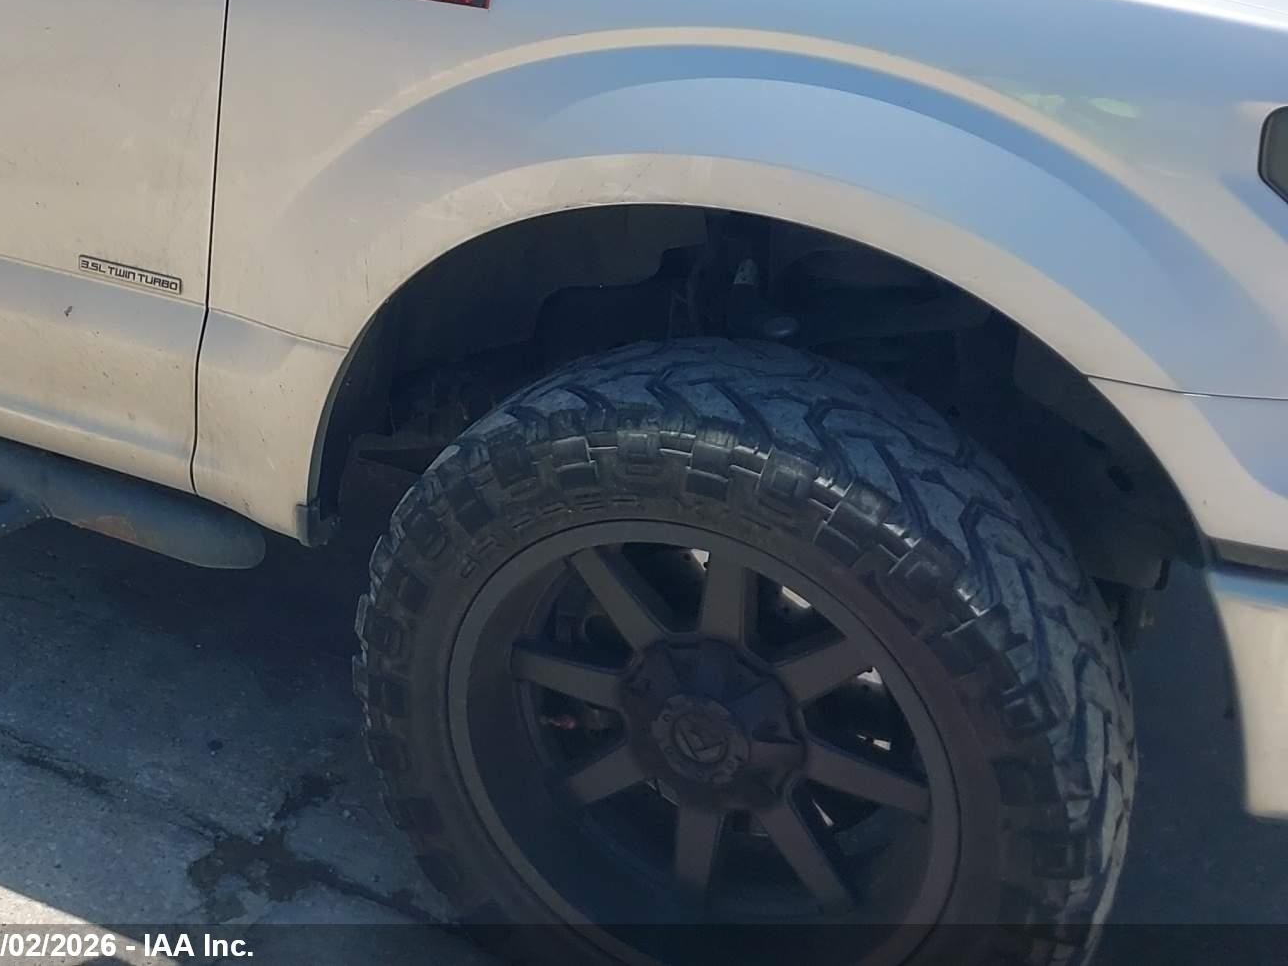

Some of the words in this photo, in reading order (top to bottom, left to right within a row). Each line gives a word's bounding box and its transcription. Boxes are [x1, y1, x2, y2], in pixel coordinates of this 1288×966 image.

[80, 259, 106, 274] 3.5L
[107, 265, 136, 281] TWIN
[137, 273, 178, 291] TURBO
